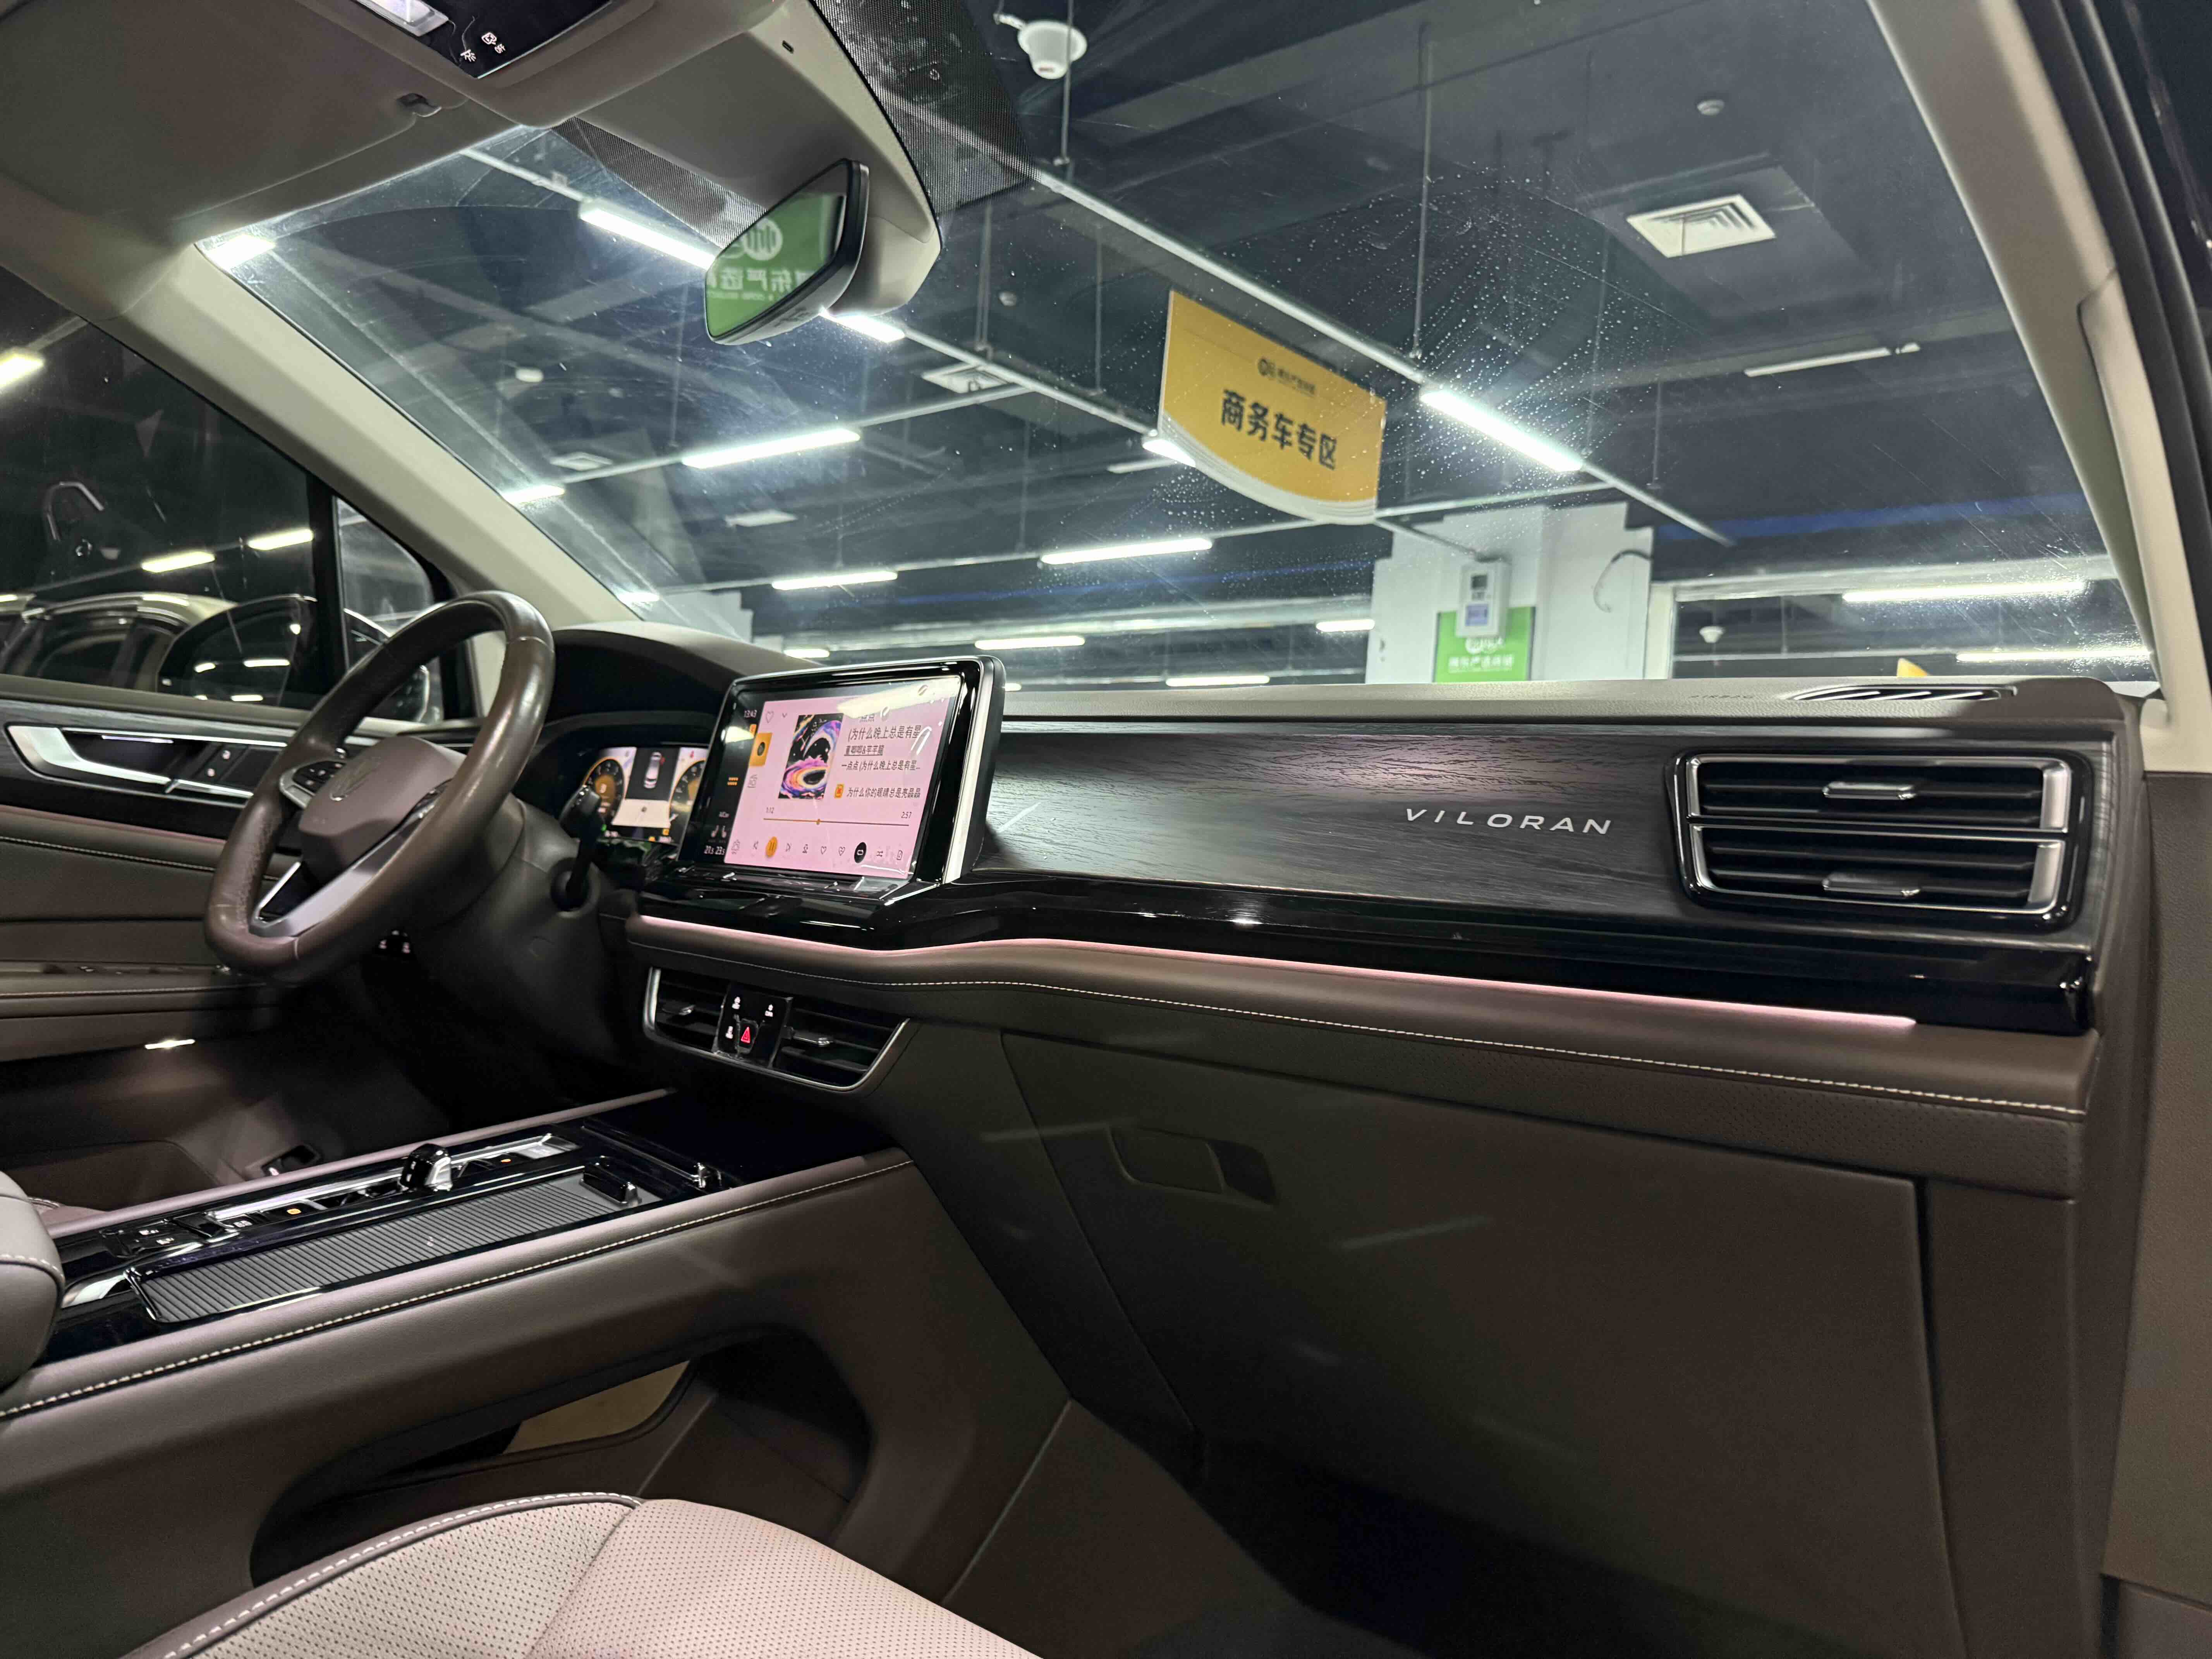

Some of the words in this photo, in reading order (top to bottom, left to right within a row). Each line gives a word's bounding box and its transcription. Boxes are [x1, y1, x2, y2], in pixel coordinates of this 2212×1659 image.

[1221, 388, 1337, 470] 商务车专区
[847, 787, 921, 798] 为什么你的眼睛总是亮晶晶
[1407, 809, 1611, 835] VILORAN
